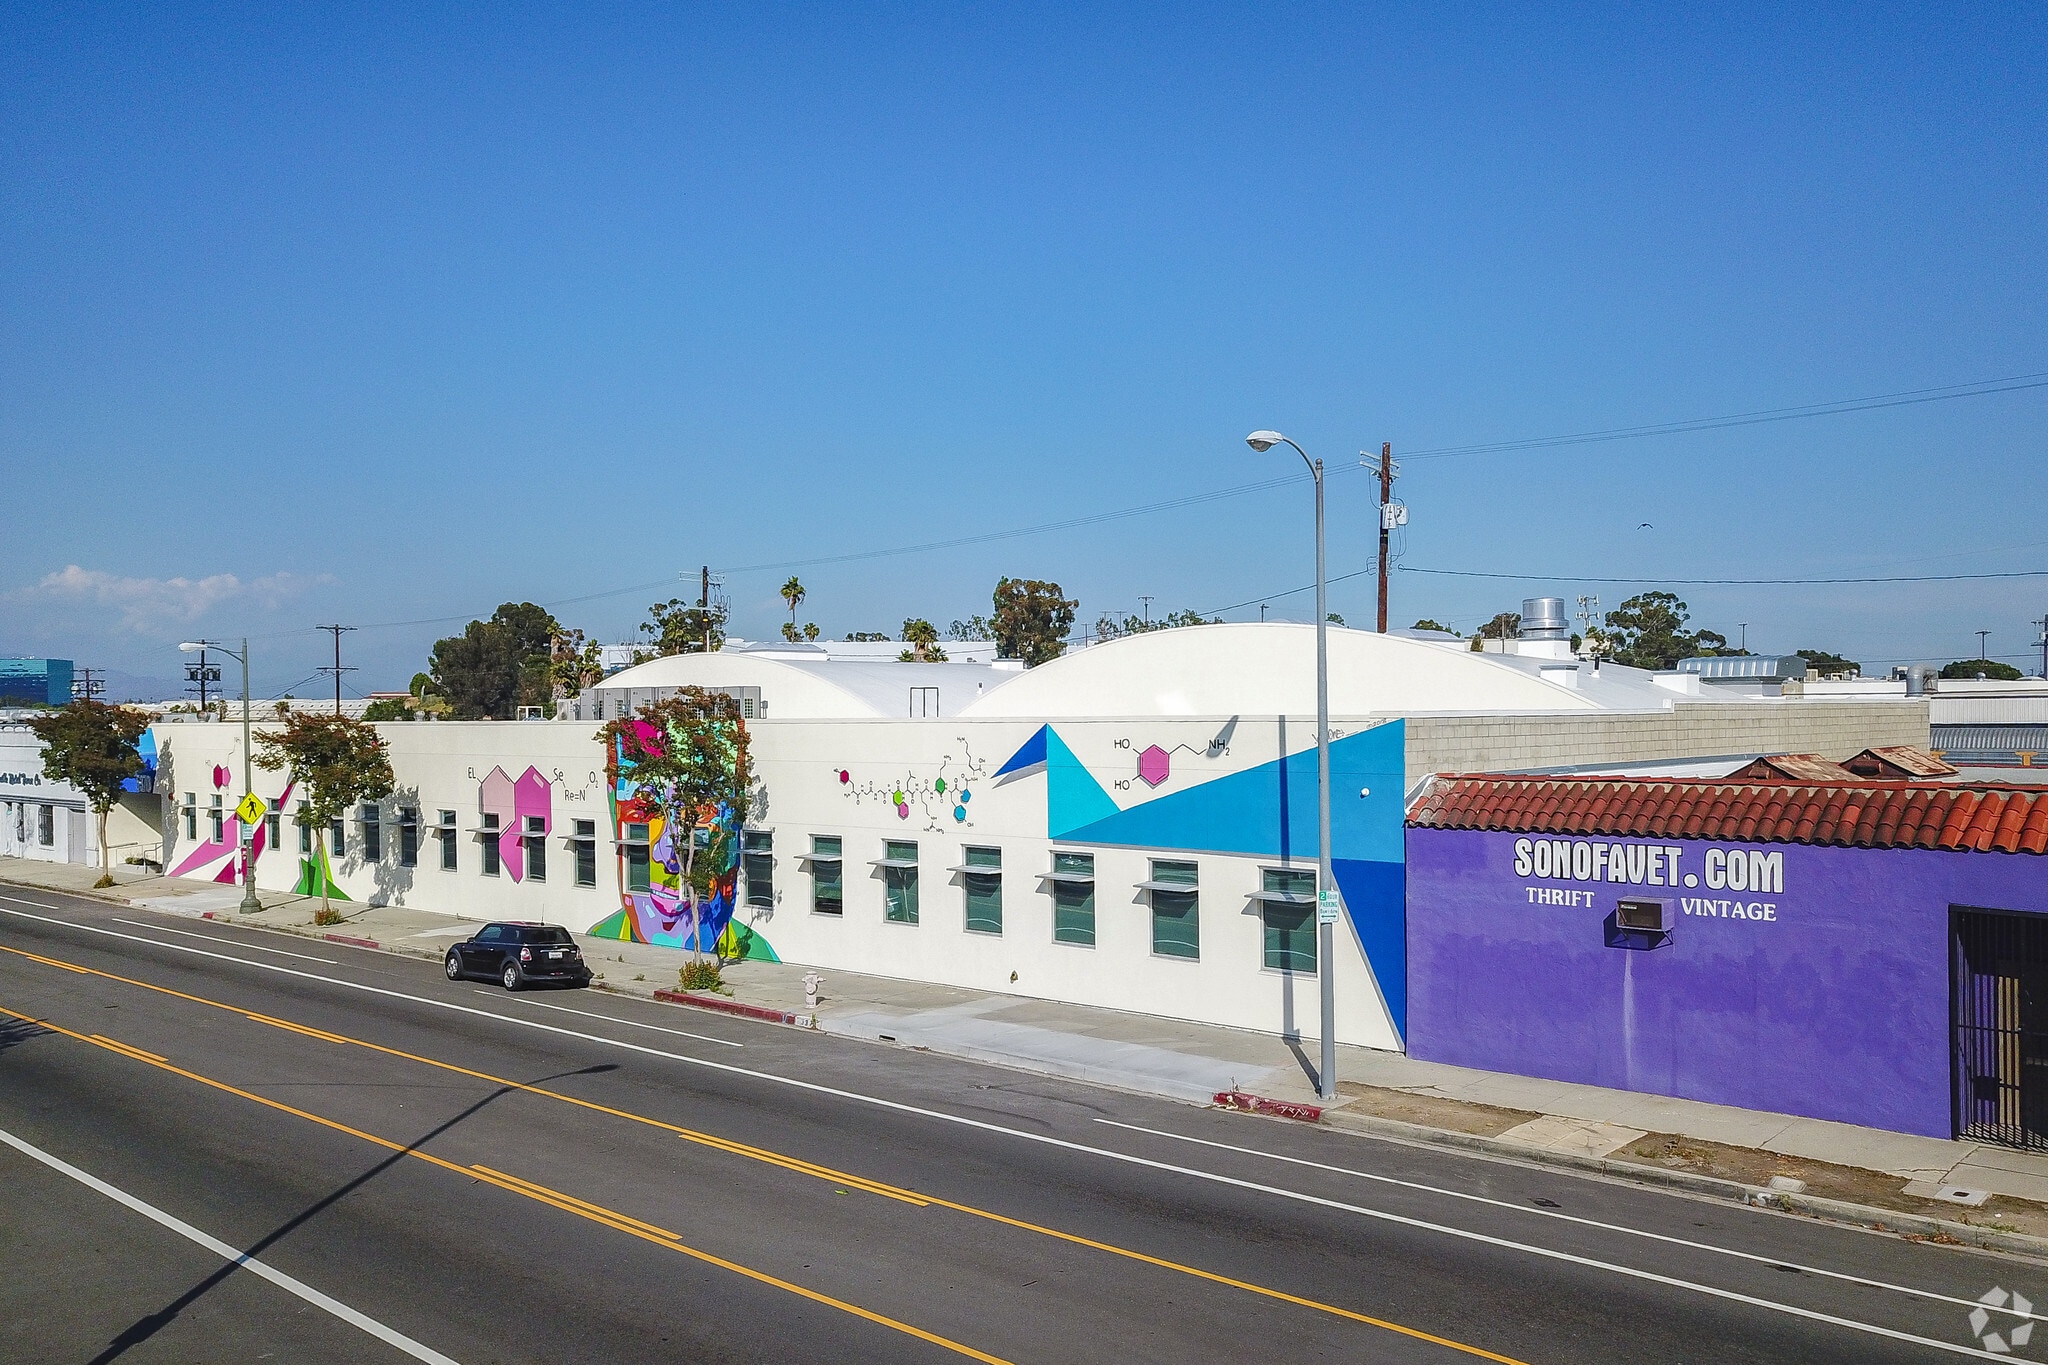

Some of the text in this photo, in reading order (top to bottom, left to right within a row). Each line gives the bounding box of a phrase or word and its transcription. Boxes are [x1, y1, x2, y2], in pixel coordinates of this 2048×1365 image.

[1114, 739, 1130, 749] HO
[553, 768, 564, 782] Se
[1114, 780, 1130, 790] HO
[1525, 886, 1595, 908] THRIFT
[1680, 898, 1777, 921] VINTAGE
